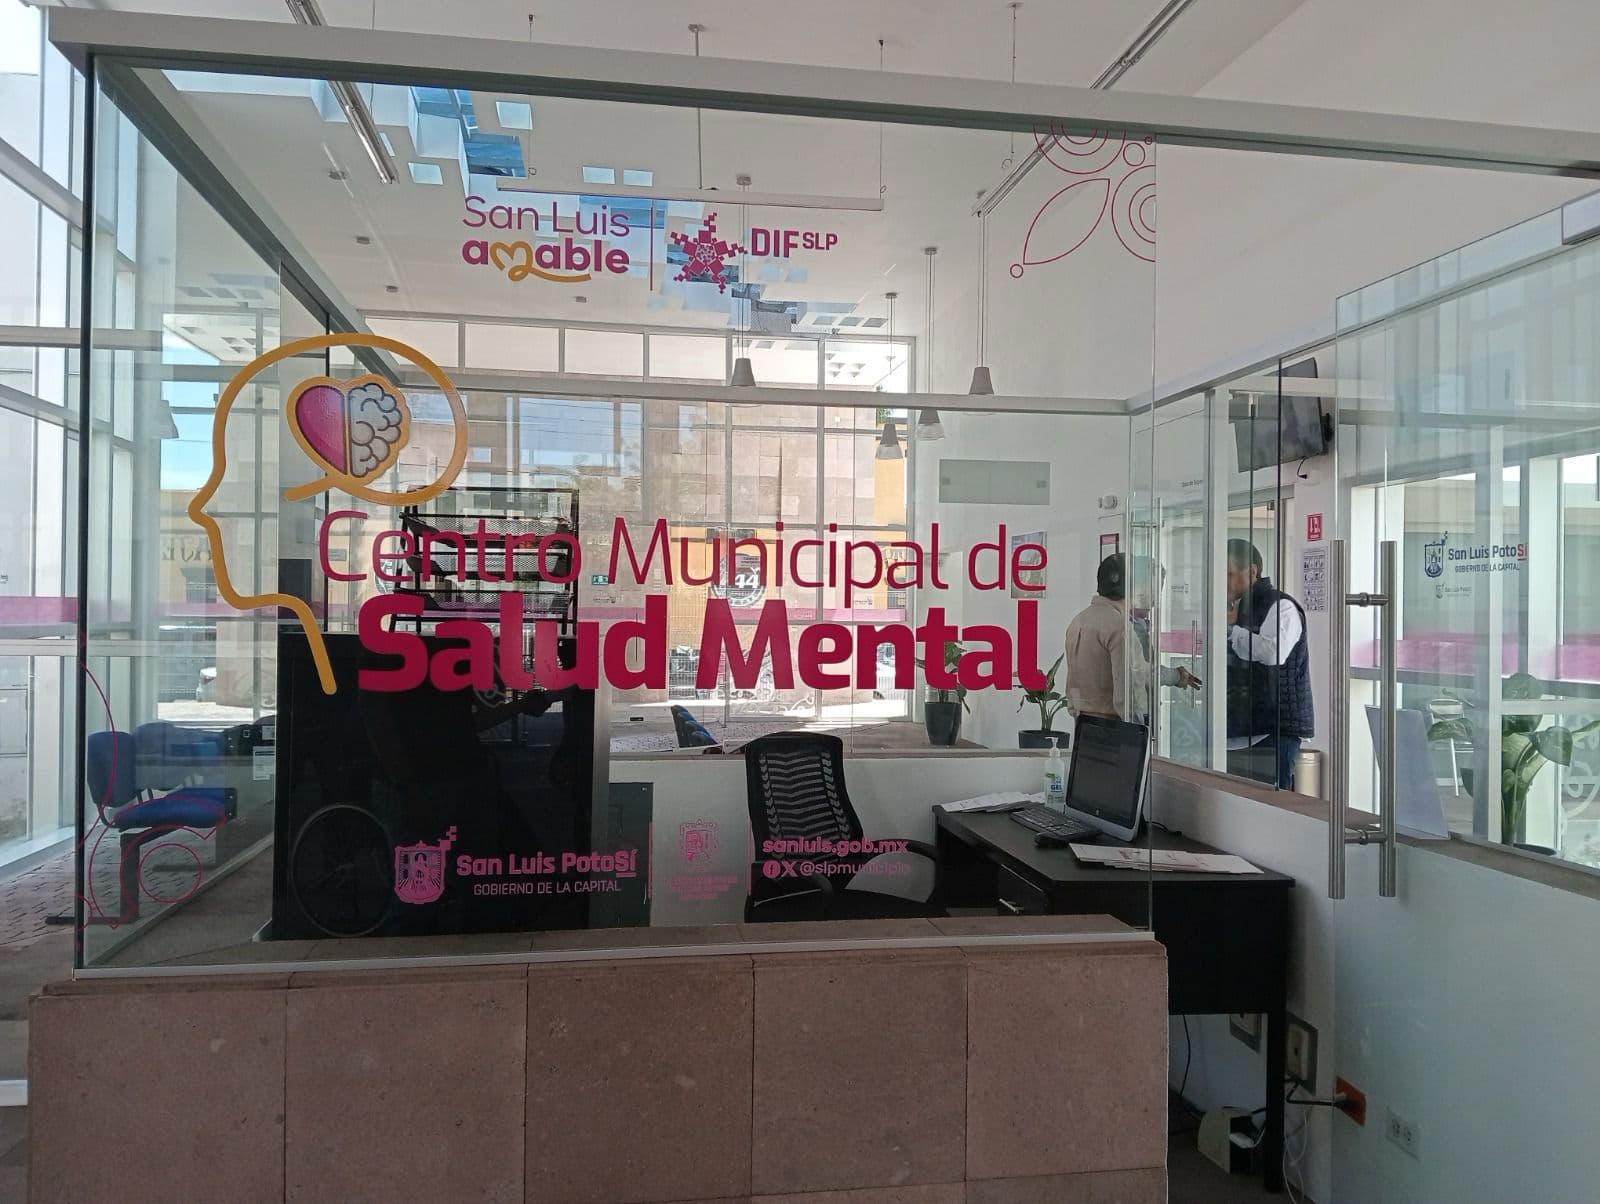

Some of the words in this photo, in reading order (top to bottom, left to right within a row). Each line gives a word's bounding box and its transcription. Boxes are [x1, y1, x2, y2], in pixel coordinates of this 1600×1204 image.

[462, 195, 540, 231] San
[552, 201, 630, 237] Luis
[751, 227, 800, 258] DIF
[802, 231, 838, 251] SLP
[462, 237, 630, 282] amable
[319, 510, 582, 584] Centro
[607, 516, 949, 609] Municipal
[968, 523, 1049, 591] de
[1448, 548, 1467, 560] San
[1469, 545, 1490, 560] Luis
[1497, 562, 1520, 571] CAPITAL
[357, 592, 669, 692] Salud
[698, 598, 1047, 692] Mental
[762, 837, 908, 857] sanluis.gob.mx
[456, 854, 502, 876] San
[508, 851, 555, 875] Luis
[473, 882, 534, 896] GOBIERNO
[537, 881, 553, 894] DE
[556, 880, 571, 893] LA
[574, 880, 622, 893] CAPITAL
